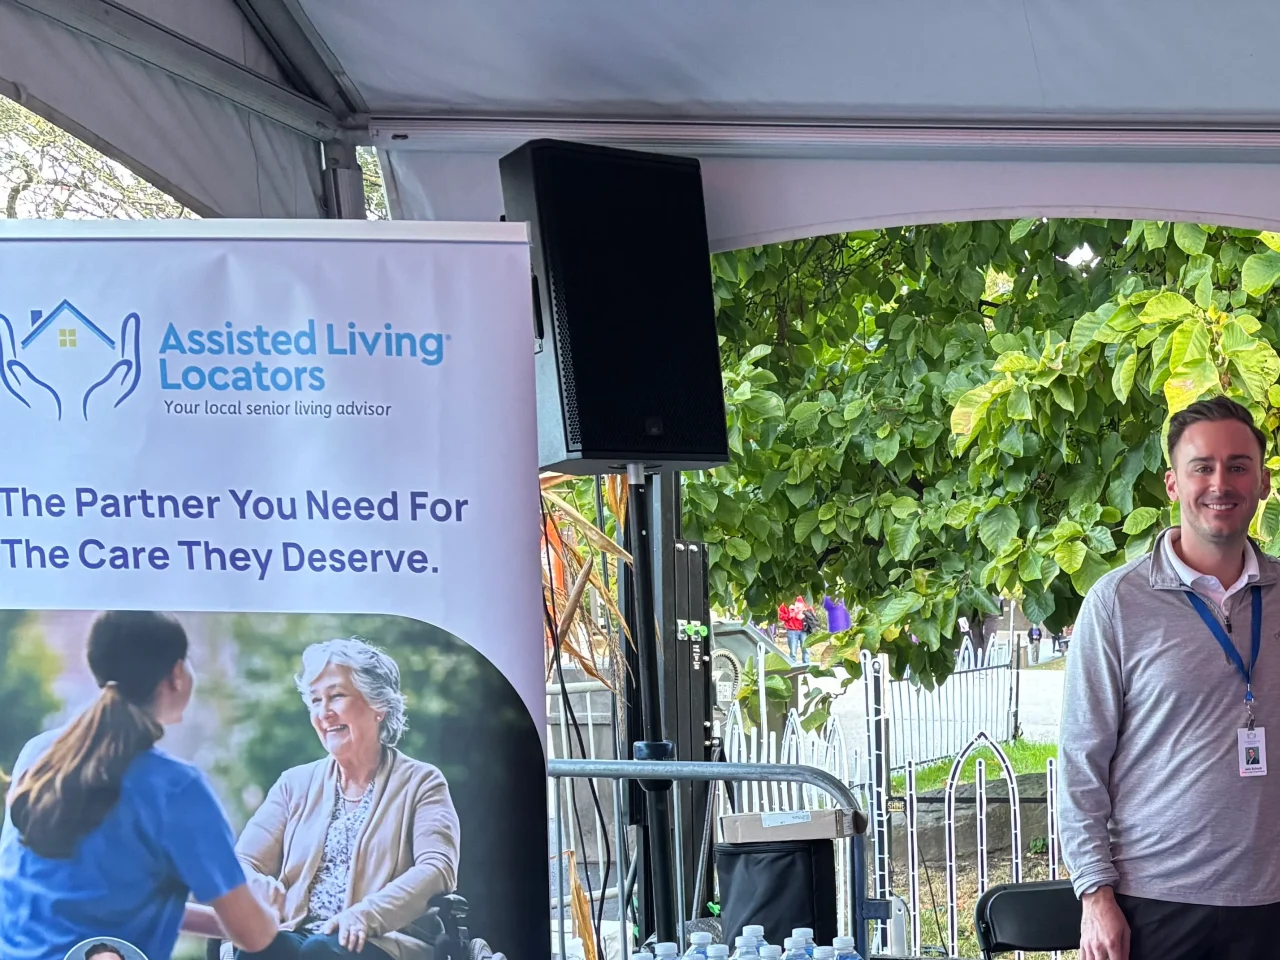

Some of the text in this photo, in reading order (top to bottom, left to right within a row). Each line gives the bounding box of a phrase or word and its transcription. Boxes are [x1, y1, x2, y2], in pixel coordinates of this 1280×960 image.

[159, 319, 444, 365] Assisted Living
[159, 359, 325, 392] Locators
[164, 400, 391, 418] Your local senior living advisor
[0, 487, 469, 522] The Partner You Need For
[1, 539, 439, 580] The Care They Deserve.
